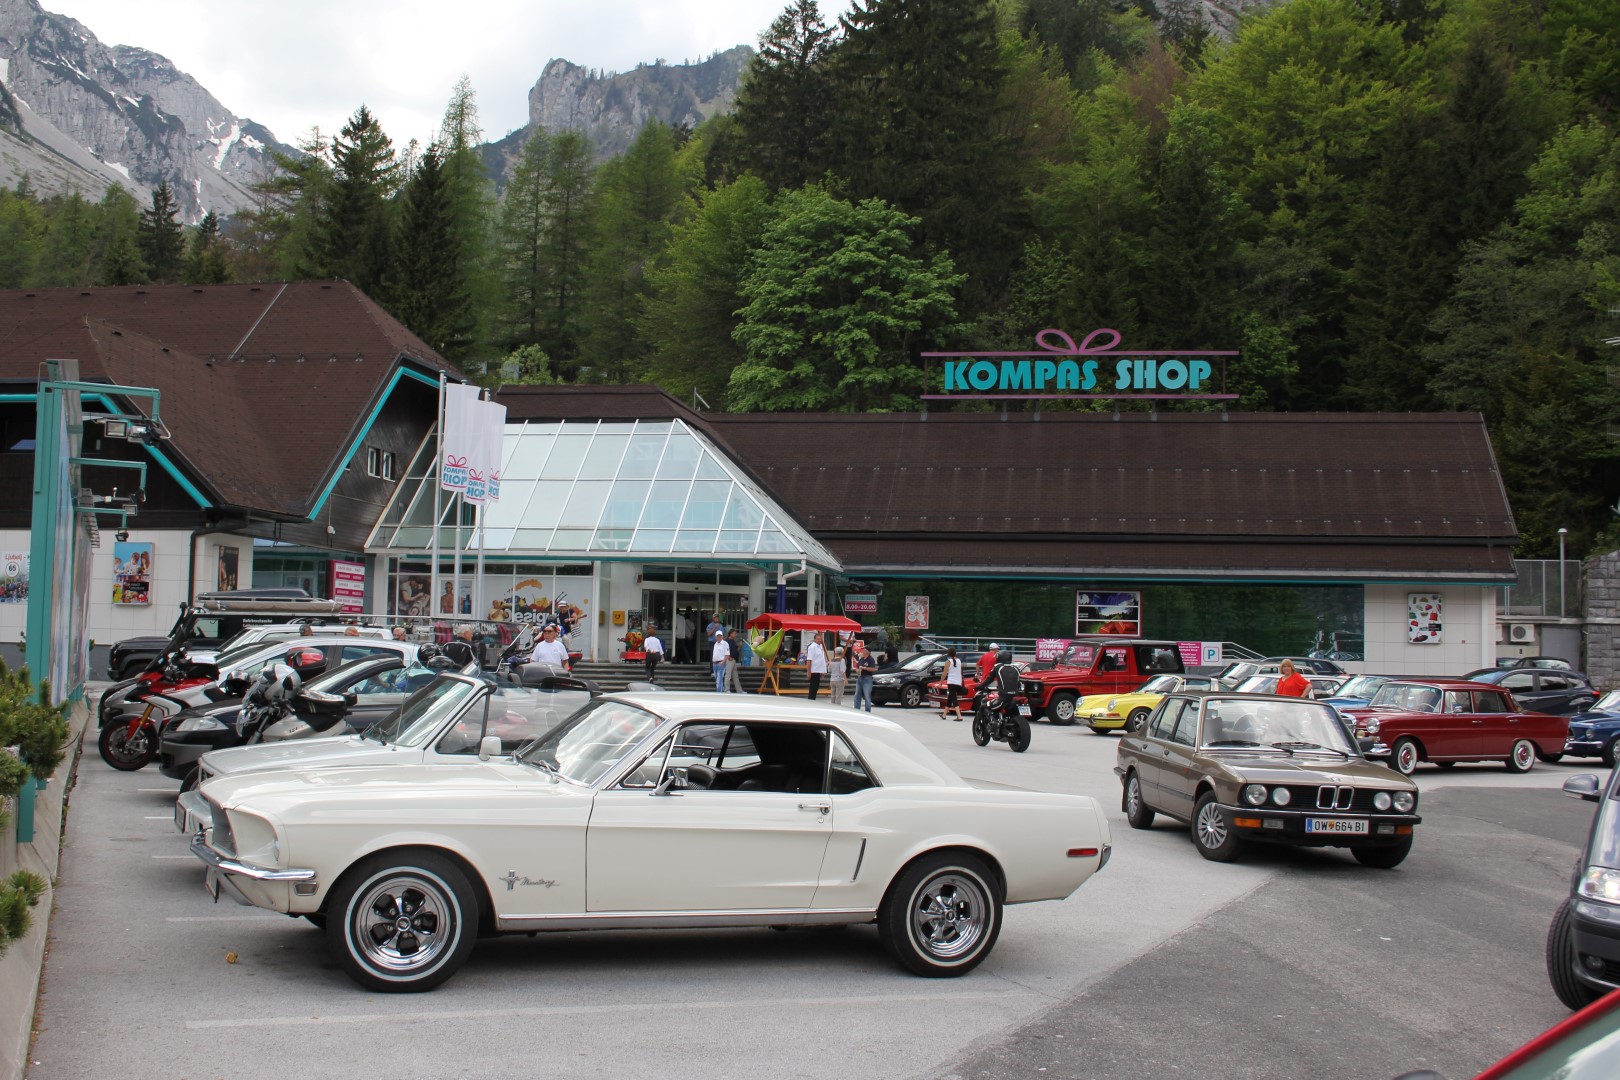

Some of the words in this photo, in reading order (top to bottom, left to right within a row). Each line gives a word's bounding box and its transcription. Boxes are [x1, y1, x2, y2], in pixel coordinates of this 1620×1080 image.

[944, 360, 1098, 390] KOMPAS
[1115, 359, 1211, 389] SHOP
[1208, 649, 1216, 660] P
[1314, 820, 1328, 830] OW
[1335, 822, 1352, 832] 664
[1355, 822, 1364, 832] BI
[520, 876, 559, 888] Mustang
